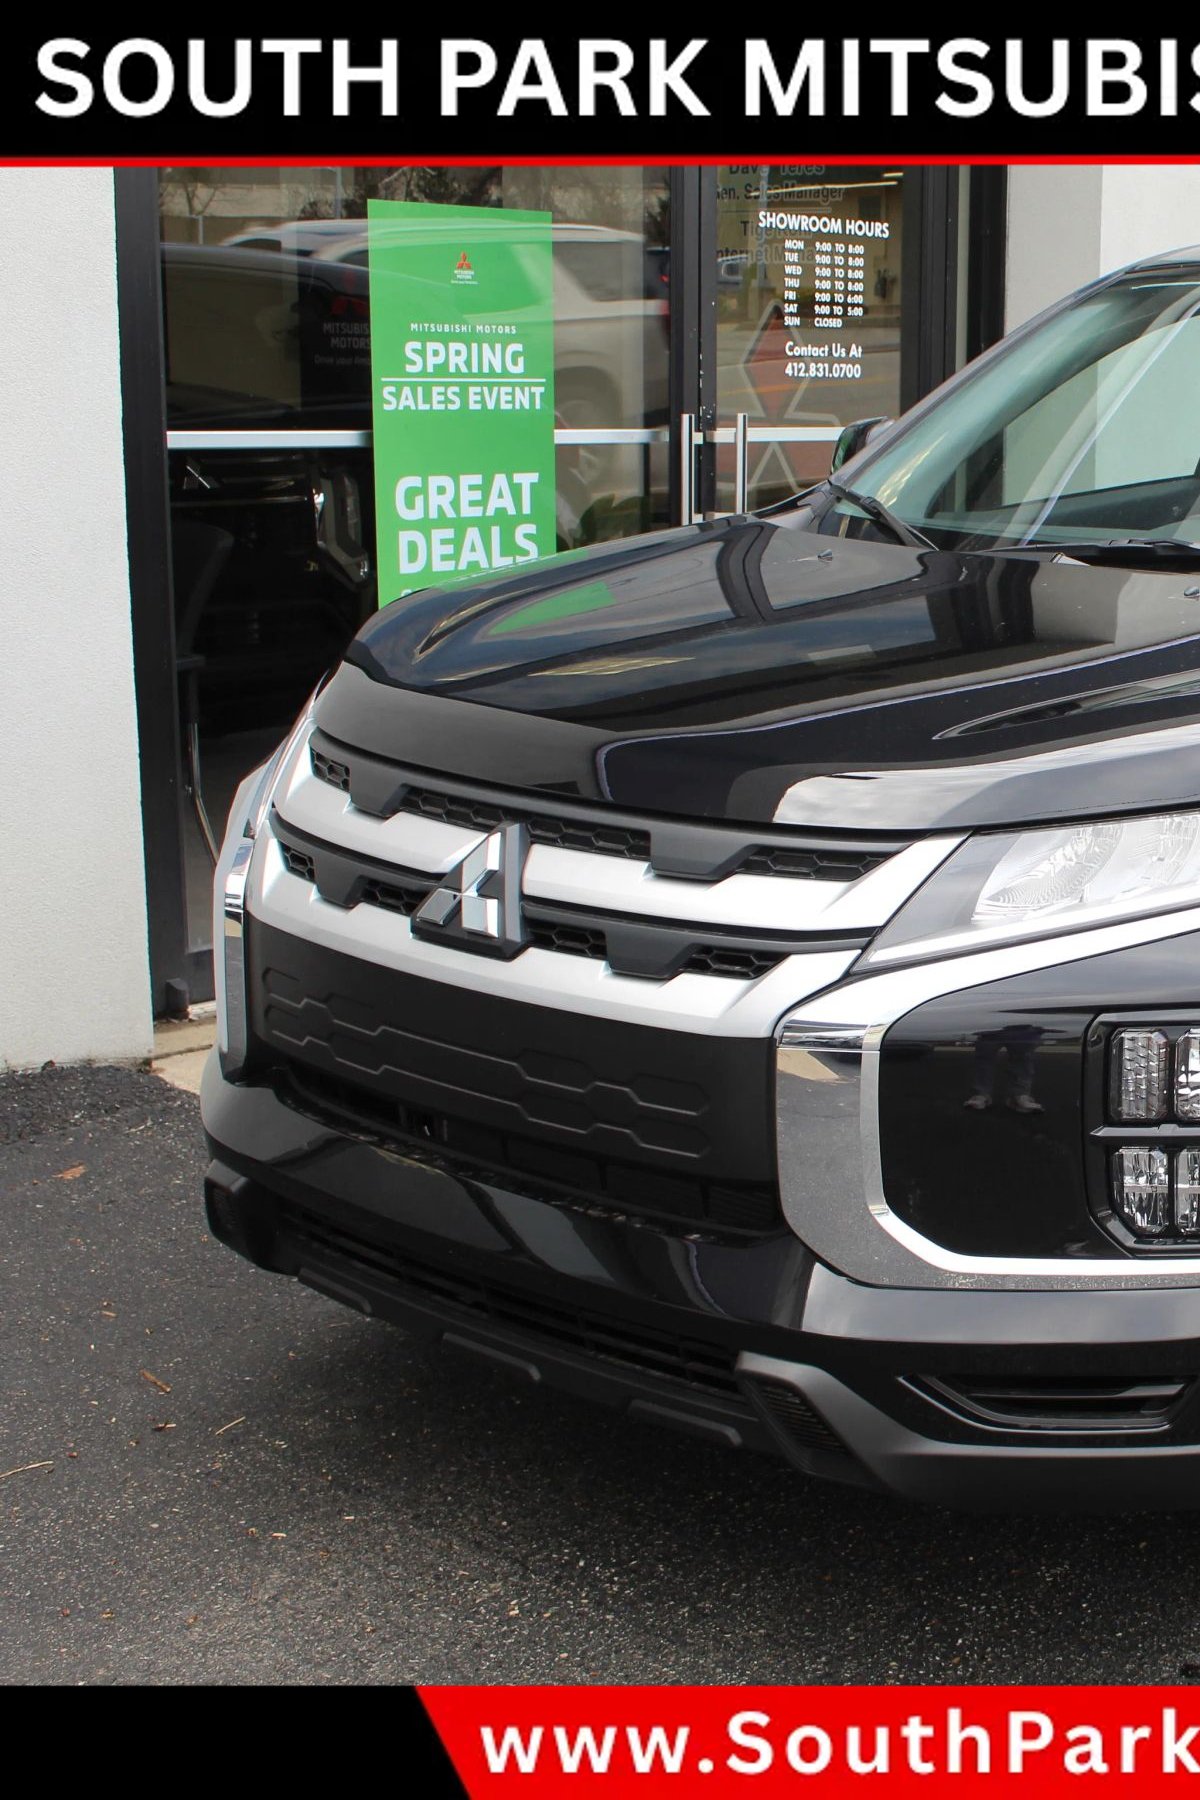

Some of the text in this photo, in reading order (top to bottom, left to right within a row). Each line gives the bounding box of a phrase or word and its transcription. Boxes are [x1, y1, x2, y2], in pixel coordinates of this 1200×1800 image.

[716, 183, 740, 200] en.
[784, 180, 845, 205] Manager
[758, 211, 843, 234] SHOWROOM
[845, 219, 890, 239] HOURS
[785, 239, 804, 250] MON
[815, 241, 832, 252] 9:00
[835, 242, 845, 253] TO
[784, 251, 799, 262] TUE
[815, 254, 831, 265] 9:00
[834, 255, 844, 266] TO
[784, 265, 802, 275] WED
[815, 267, 831, 277] 9:00
[834, 268, 844, 278] TO
[784, 277, 800, 288] THU
[815, 279, 831, 290] 9:00
[834, 280, 844, 291] TO
[784, 290, 796, 300] FRI
[814, 292, 831, 302] 9:00
[834, 293, 844, 303] TO
[784, 302, 798, 313] SAT
[814, 304, 831, 315] 9:00
[833, 305, 843, 316] TO
[323, 321, 370, 335] MITSUBIS
[410, 323, 517, 334] MITSUBISHI MOTORS
[784, 315, 843, 328] SUN CLOSED
[404, 341, 525, 374] SPRING
[785, 341, 863, 359] Contact Us At
[785, 362, 861, 378] 412.831.0700
[382, 386, 545, 411] SALES EVENT
[395, 472, 539, 521] GREAT
[398, 523, 538, 575] DEALS
